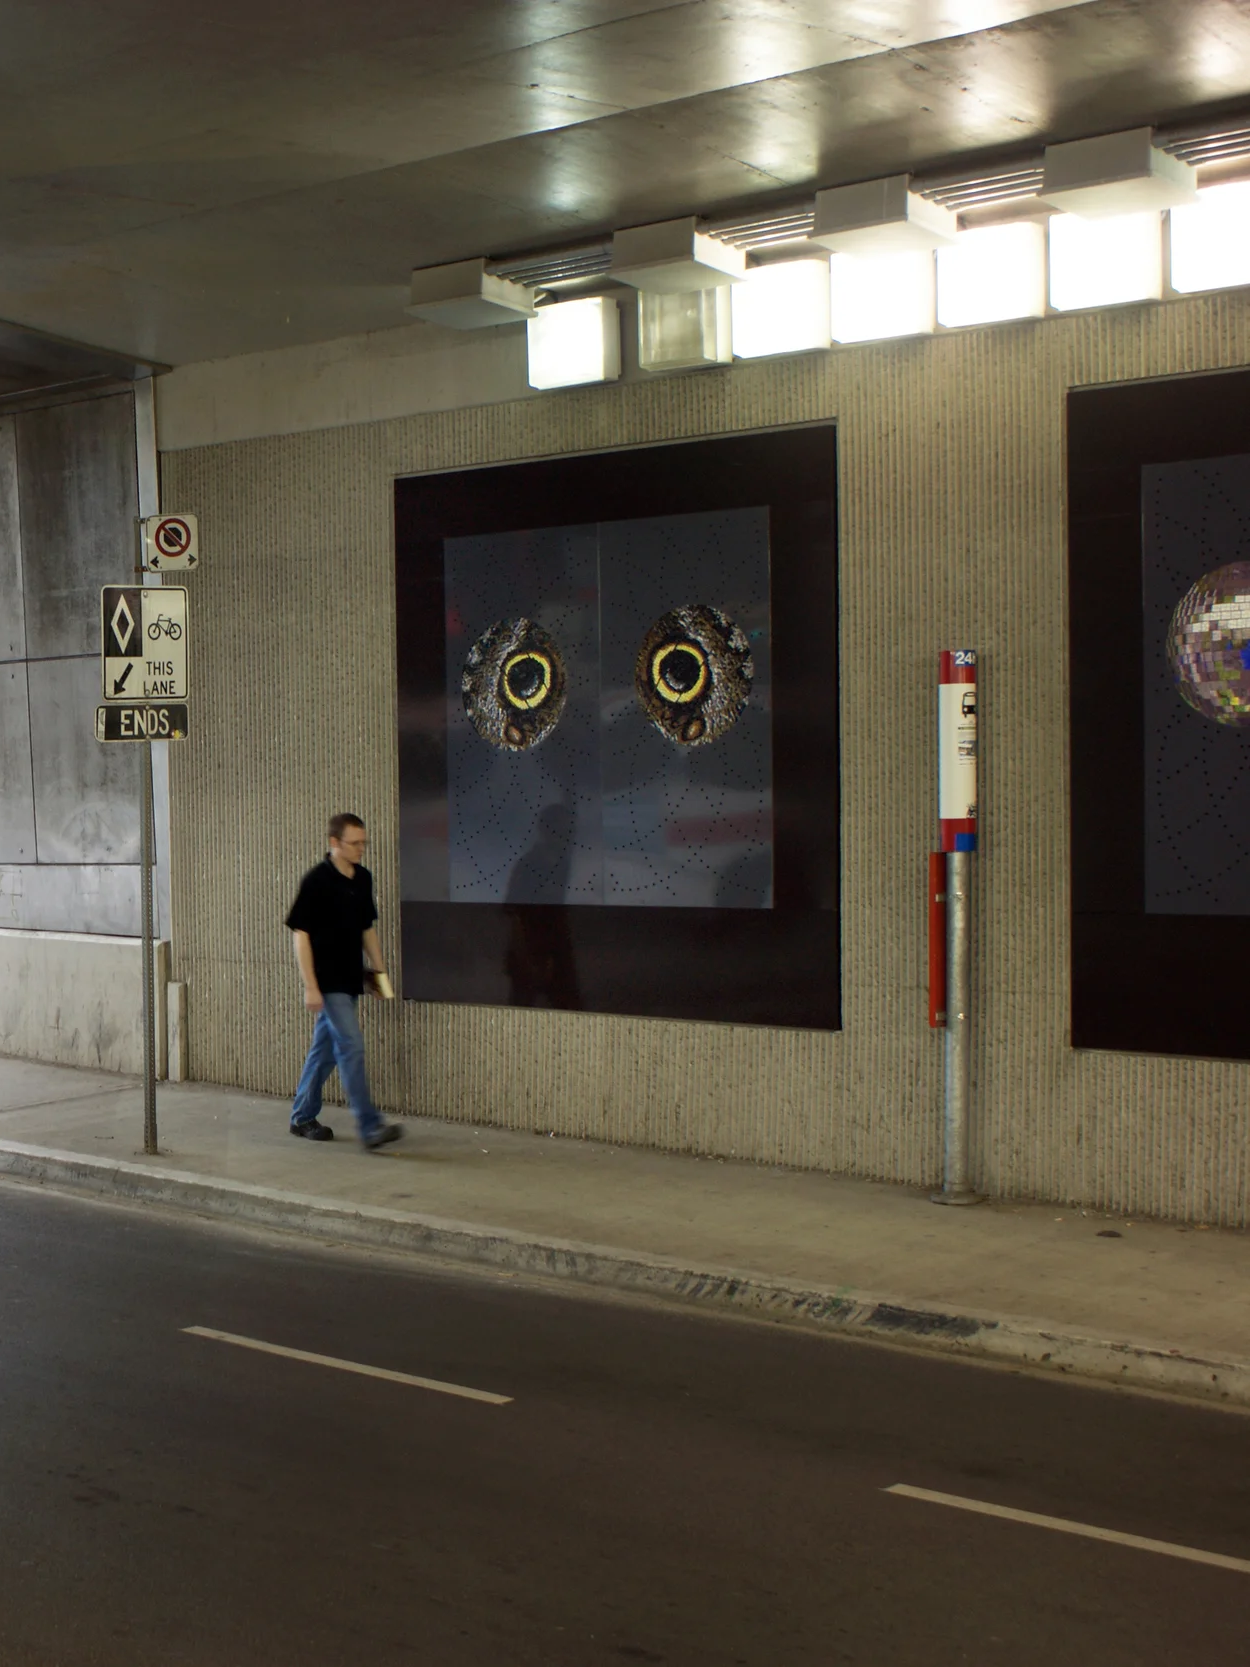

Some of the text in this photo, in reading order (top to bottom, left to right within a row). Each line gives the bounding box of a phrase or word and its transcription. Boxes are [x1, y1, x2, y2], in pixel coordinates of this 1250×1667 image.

[146, 661, 174, 676] THIS
[143, 680, 176, 695] LANE
[120, 708, 170, 736] ENDS
